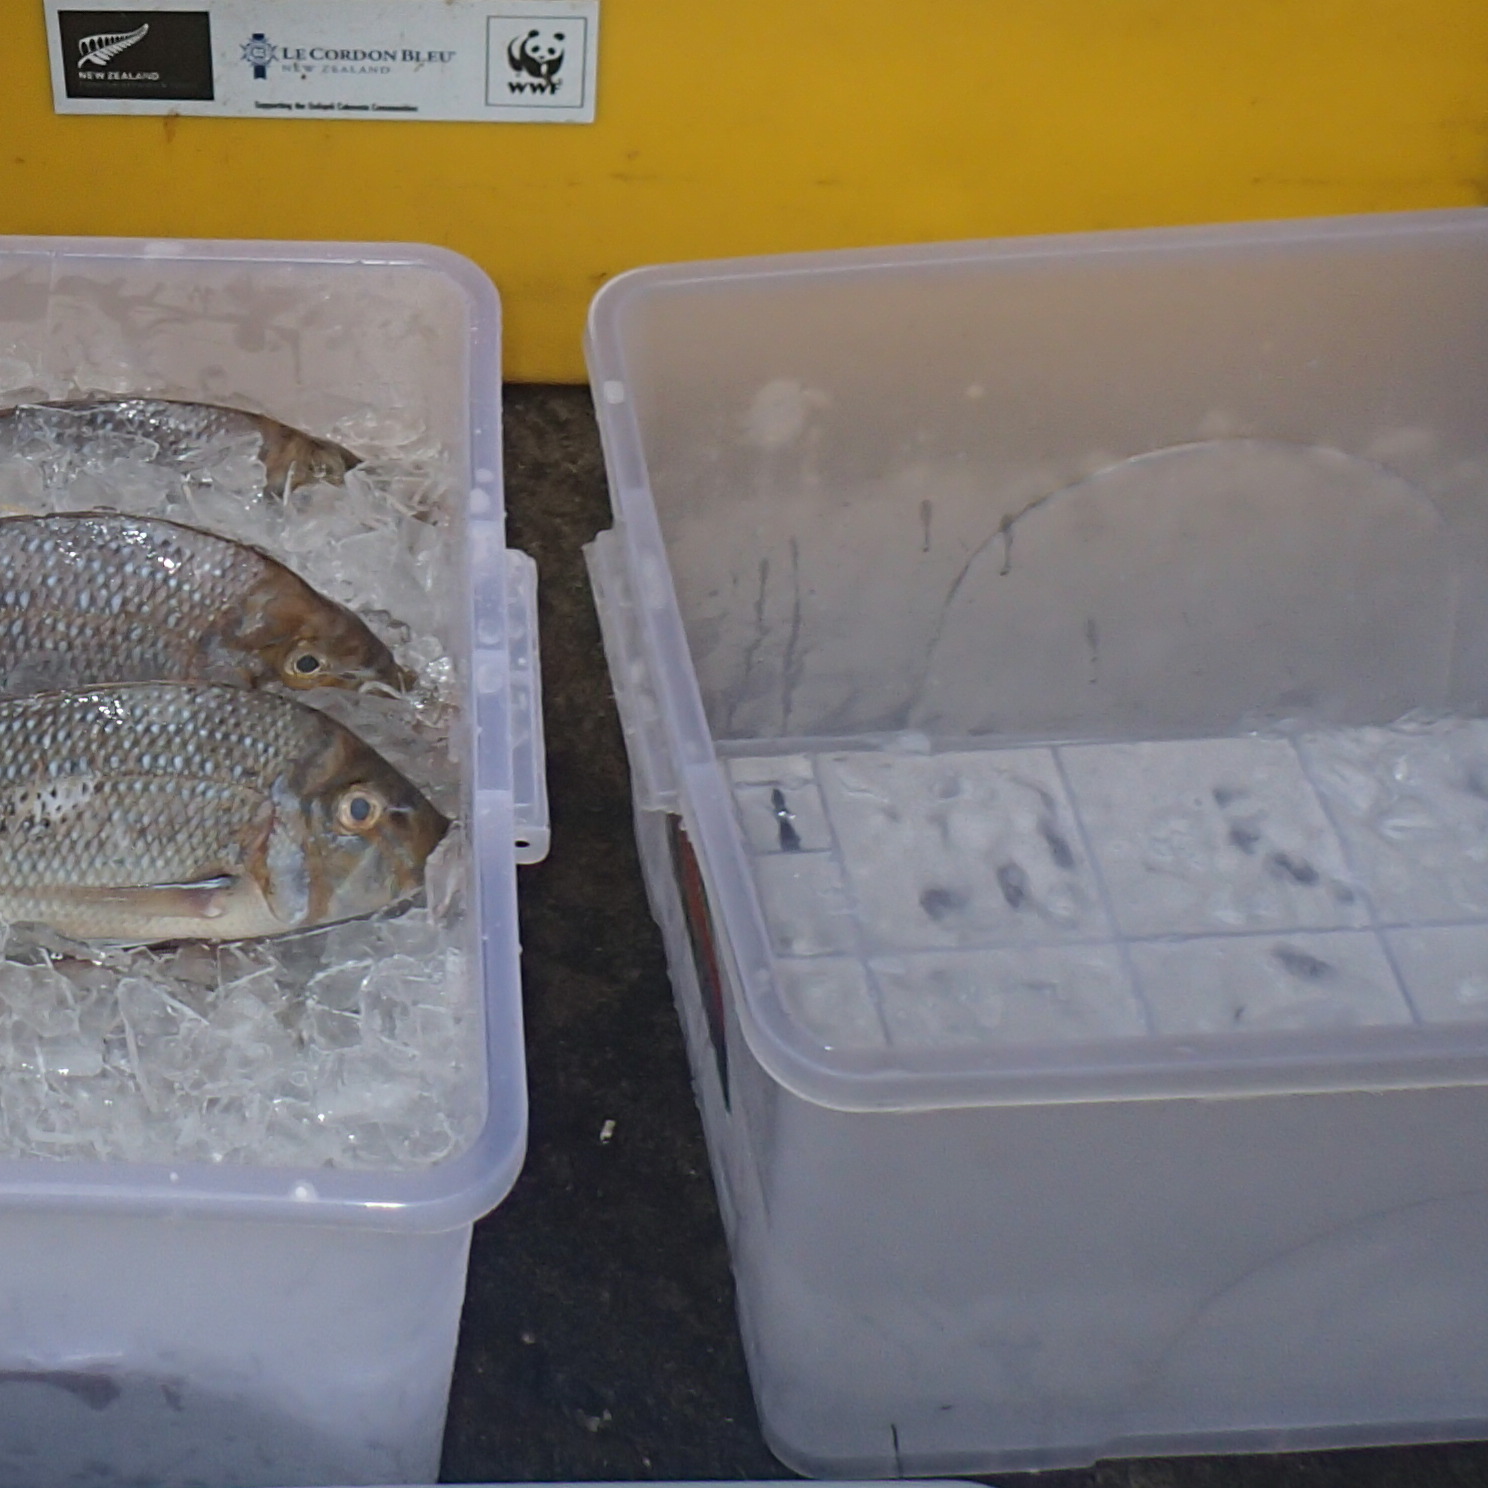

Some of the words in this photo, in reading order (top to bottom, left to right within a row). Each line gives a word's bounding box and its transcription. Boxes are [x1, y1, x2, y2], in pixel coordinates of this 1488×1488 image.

[282, 47, 307, 61] LE
[309, 47, 397, 62] CORDON
[400, 49, 453, 63] BLEU
[321, 65, 391, 75] ZEALAND
[78, 72, 105, 80] NEW
[107, 72, 160, 81] ZEALAND
[508, 81, 562, 95] WWF
